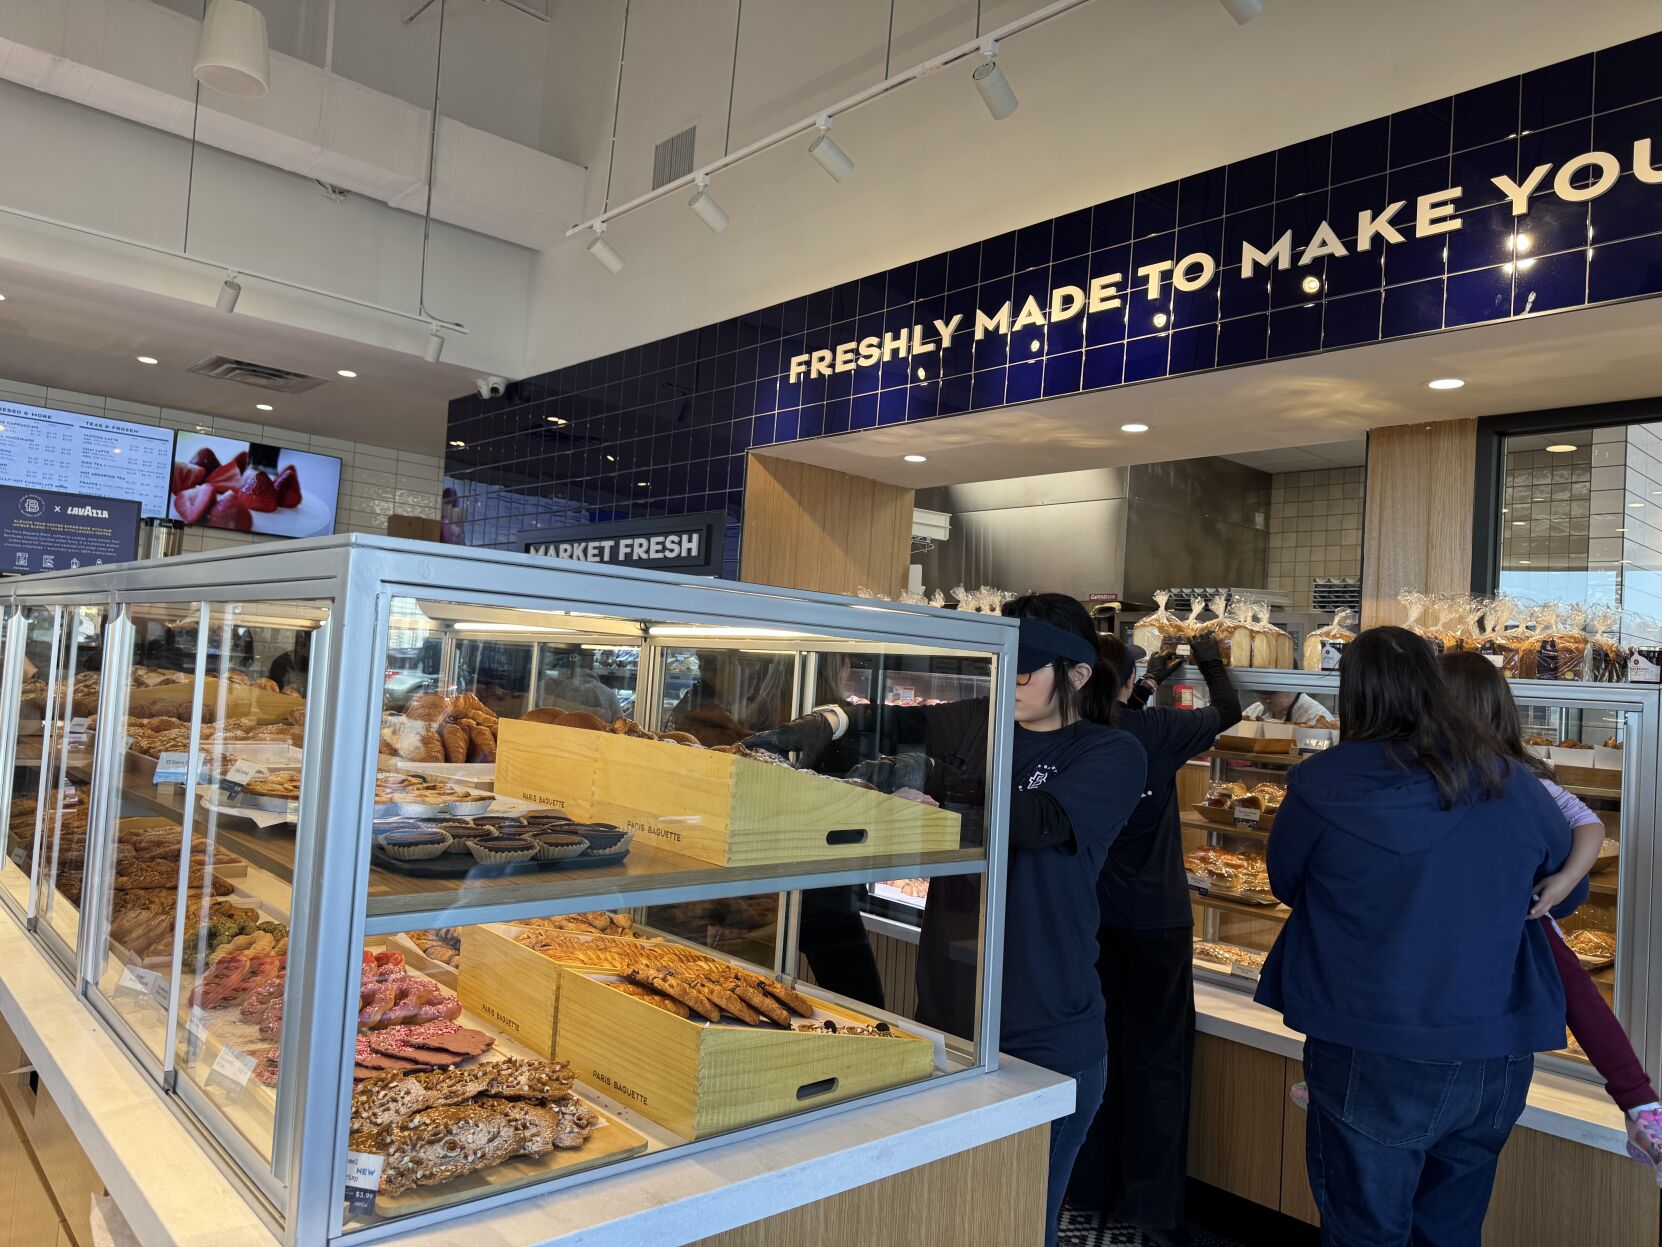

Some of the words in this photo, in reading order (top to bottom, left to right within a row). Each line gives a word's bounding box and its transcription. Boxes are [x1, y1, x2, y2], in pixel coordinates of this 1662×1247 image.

[788, 313, 964, 384] FRESHLY
[974, 272, 1123, 341] MADE
[1137, 252, 1216, 301] TO
[1241, 186, 1464, 279] MAKE
[111, 425, 139, 434] FROZEN
[66, 505, 109, 519] LAVAZZA
[618, 533, 700, 561] FRESH
[522, 792, 537, 803] PARIS
[538, 796, 565, 809] BAGUETTE
[647, 826, 682, 842] BAGUETTE
[482, 1003, 495, 1018] PARIS
[496, 1011, 520, 1032] BAGUETTE
[592, 1070, 611, 1086] PARIS
[613, 1081, 648, 1106] BAGUETTE
[356, 1167, 375, 1177] NEW
